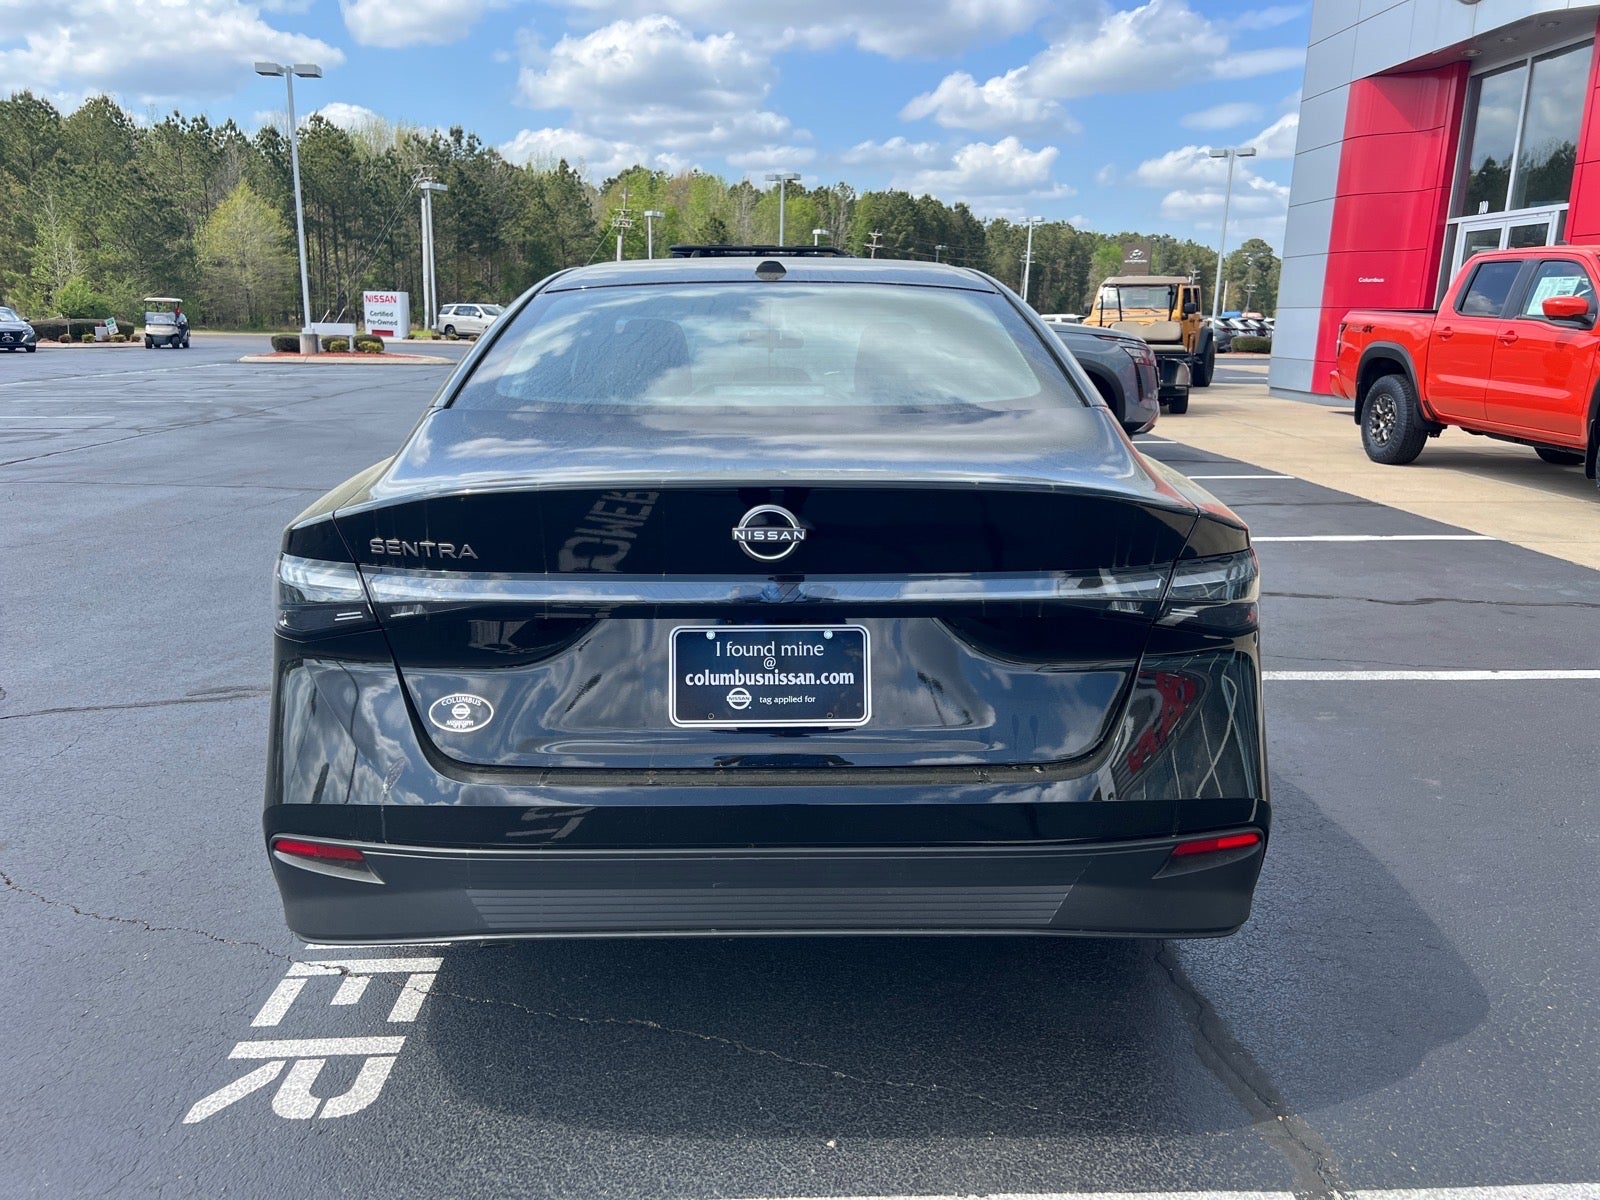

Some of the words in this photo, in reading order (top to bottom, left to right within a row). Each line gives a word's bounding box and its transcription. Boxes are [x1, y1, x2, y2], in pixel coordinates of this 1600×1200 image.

[365, 295, 397, 303] NISSAN
[732, 529, 806, 541] NISSAN
[369, 538, 479, 560] SENTRA
[715, 641, 721, 657] I
[726, 641, 775, 657] found
[781, 641, 825, 657] mine
[763, 656, 776, 670] @
[685, 669, 855, 686] columbusnissan.com
[441, 696, 482, 706] COLUMBUS
[759, 696, 773, 705] tag
[774, 695, 803, 705] applied
[804, 695, 816, 703] for
